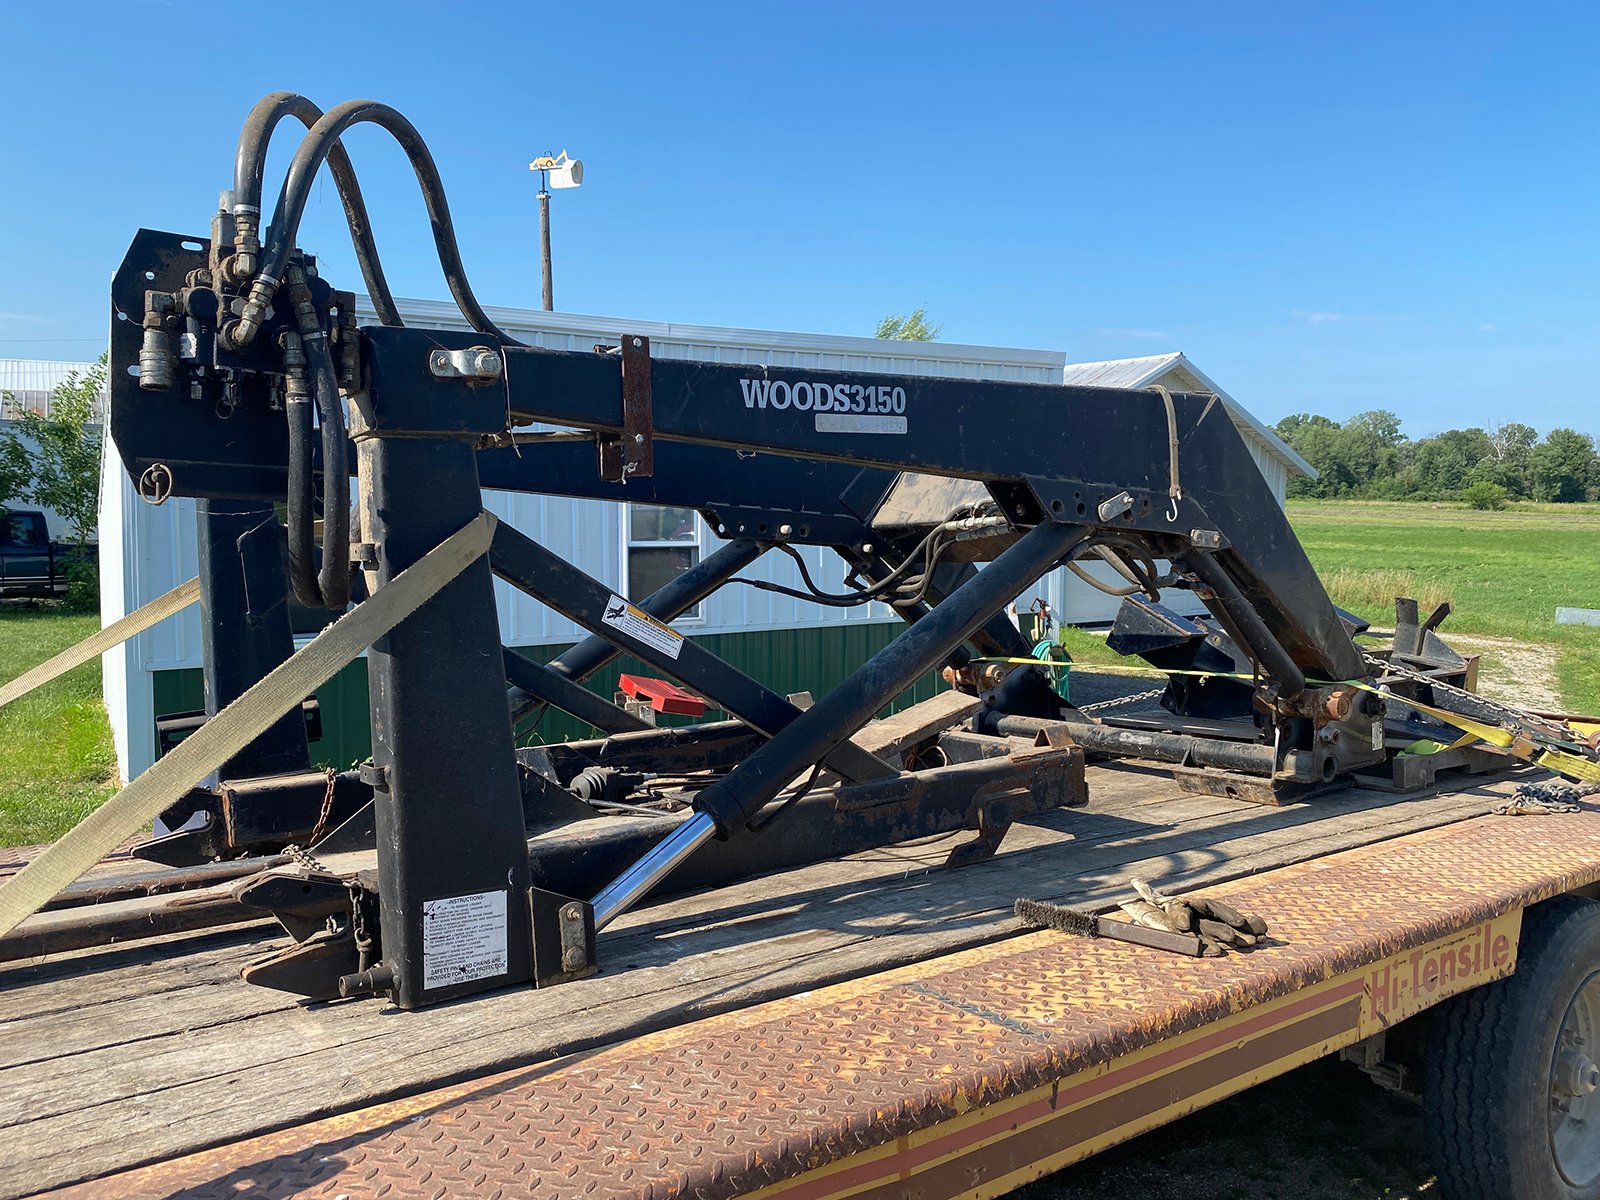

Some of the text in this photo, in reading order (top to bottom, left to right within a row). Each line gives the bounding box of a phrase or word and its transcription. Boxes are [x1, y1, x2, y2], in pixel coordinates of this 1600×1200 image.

[426, 973, 450, 982] PROVIDED
[476, 963, 504, 973] PROTECTION
[1370, 923, 1510, 1021] Hi-Tensile
